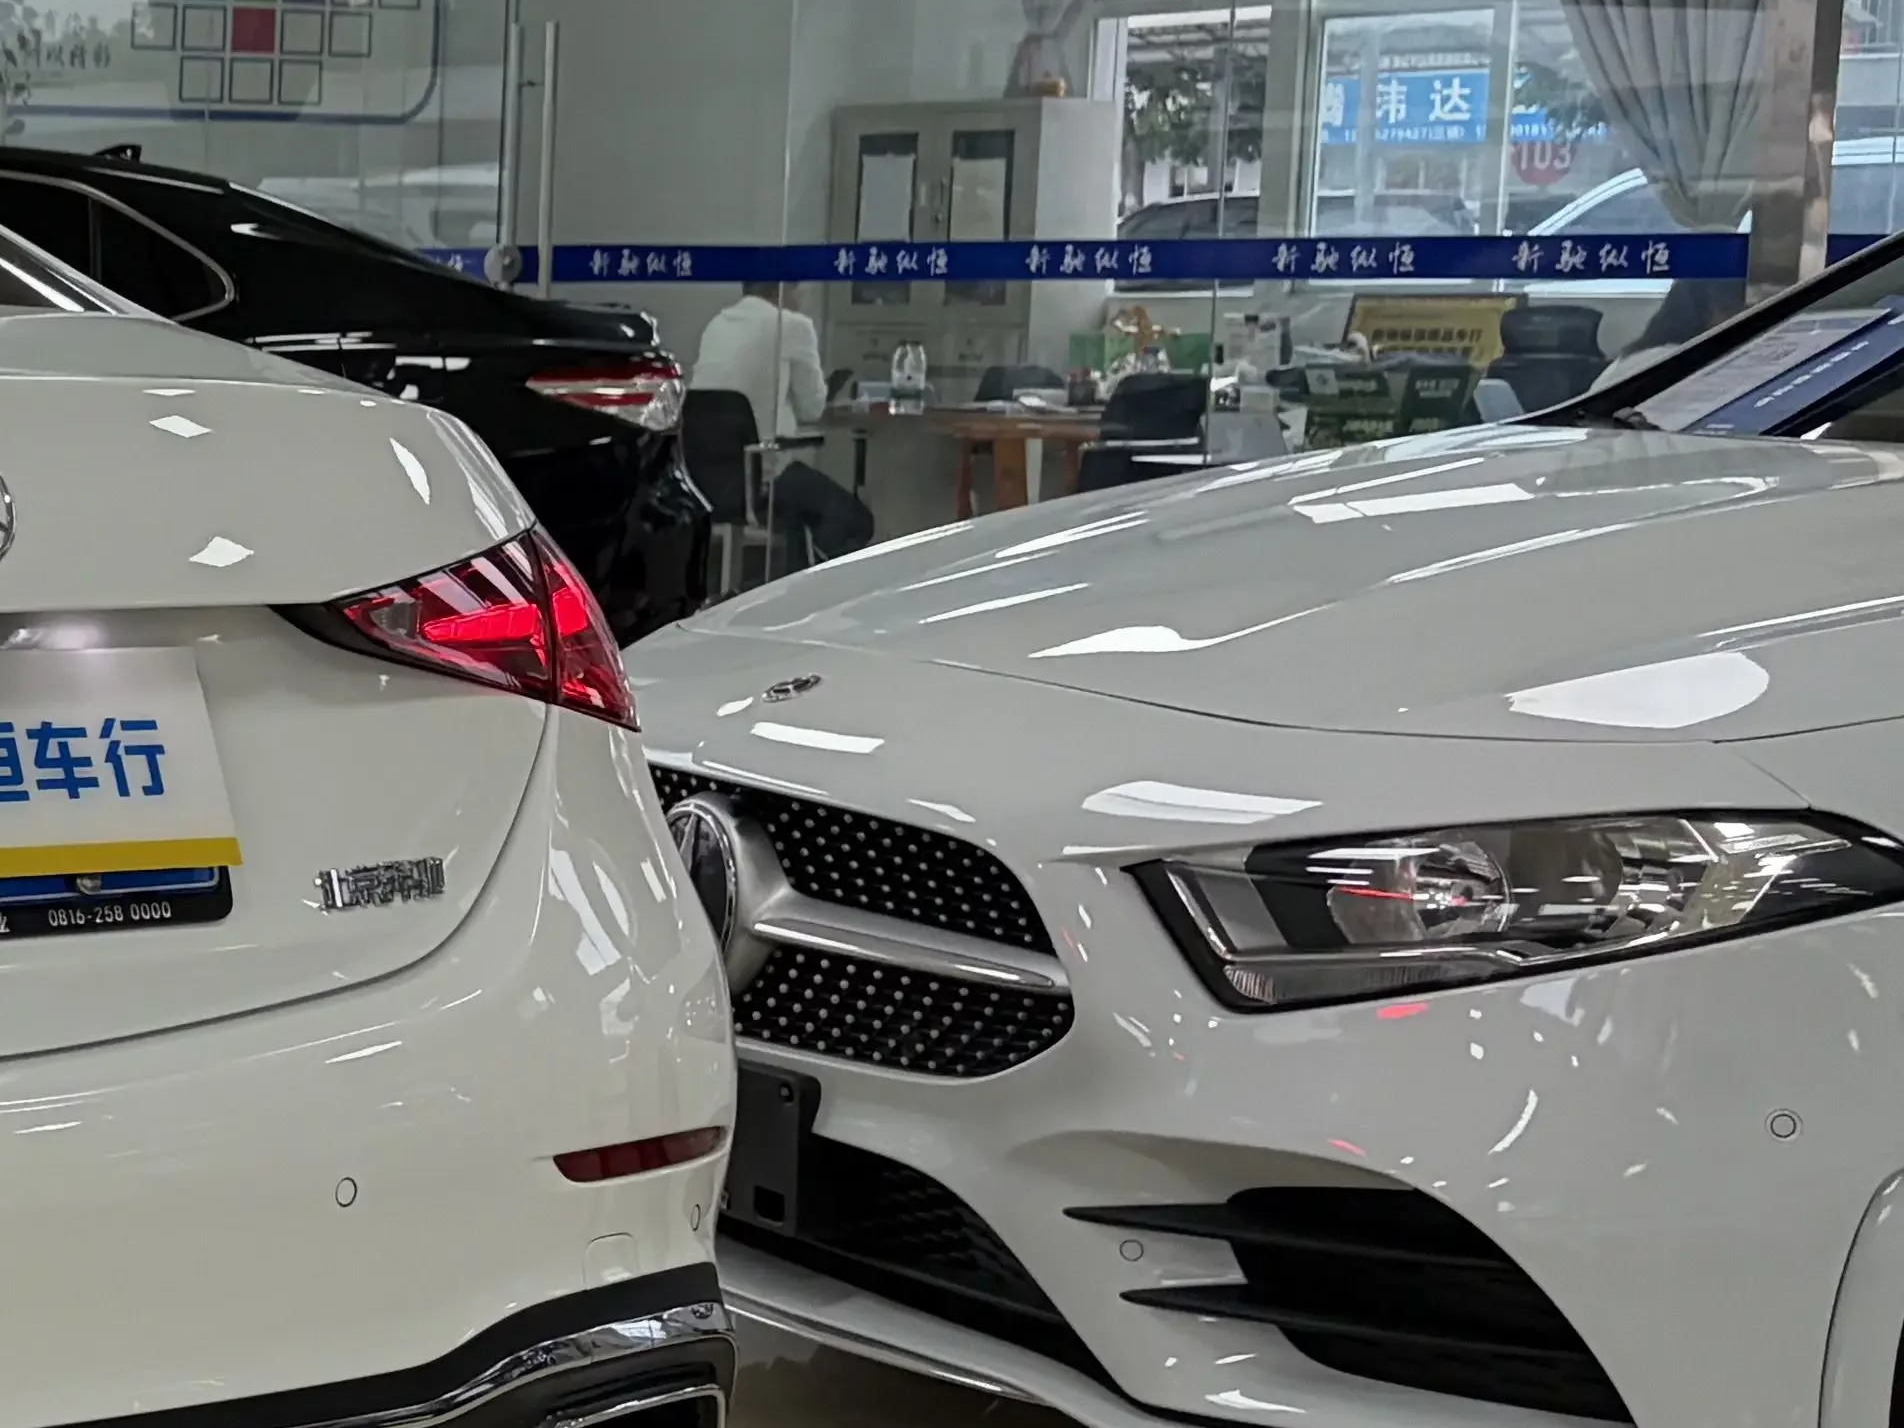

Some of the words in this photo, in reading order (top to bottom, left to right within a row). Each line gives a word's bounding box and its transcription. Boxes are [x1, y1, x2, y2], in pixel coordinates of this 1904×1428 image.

[1272, 241, 1415, 272] 新驰纵恒
[1512, 240, 1670, 272] 新驰纵恒
[48, 904, 124, 926] 0816-258
[130, 901, 172, 920] 0000
